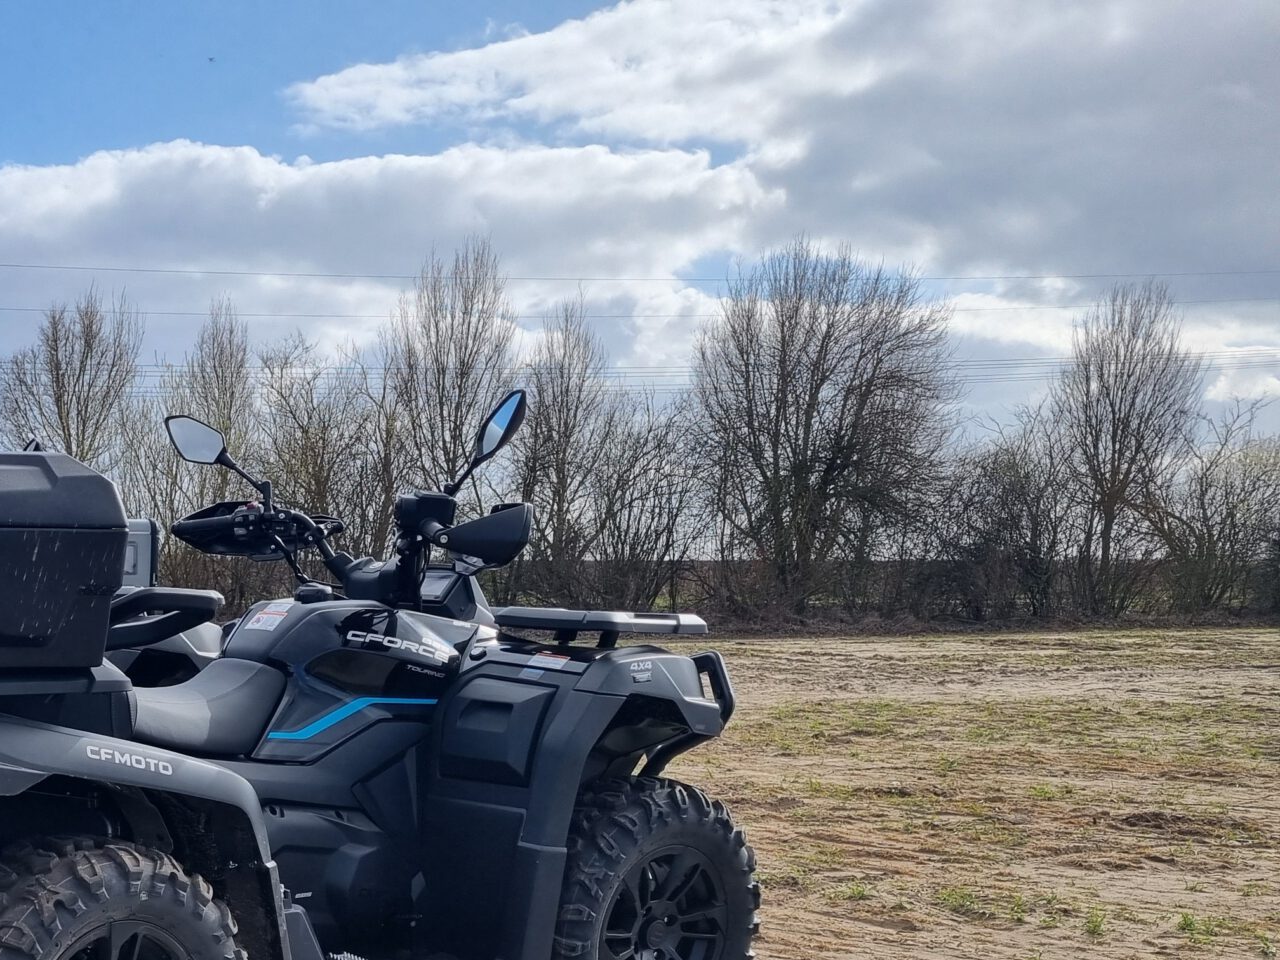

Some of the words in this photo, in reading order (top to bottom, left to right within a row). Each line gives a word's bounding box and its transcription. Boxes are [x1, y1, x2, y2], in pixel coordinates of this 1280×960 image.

[346, 630, 449, 663] CFORCE
[406, 664, 446, 678] TOURING
[86, 745, 173, 776] CFMOTO
